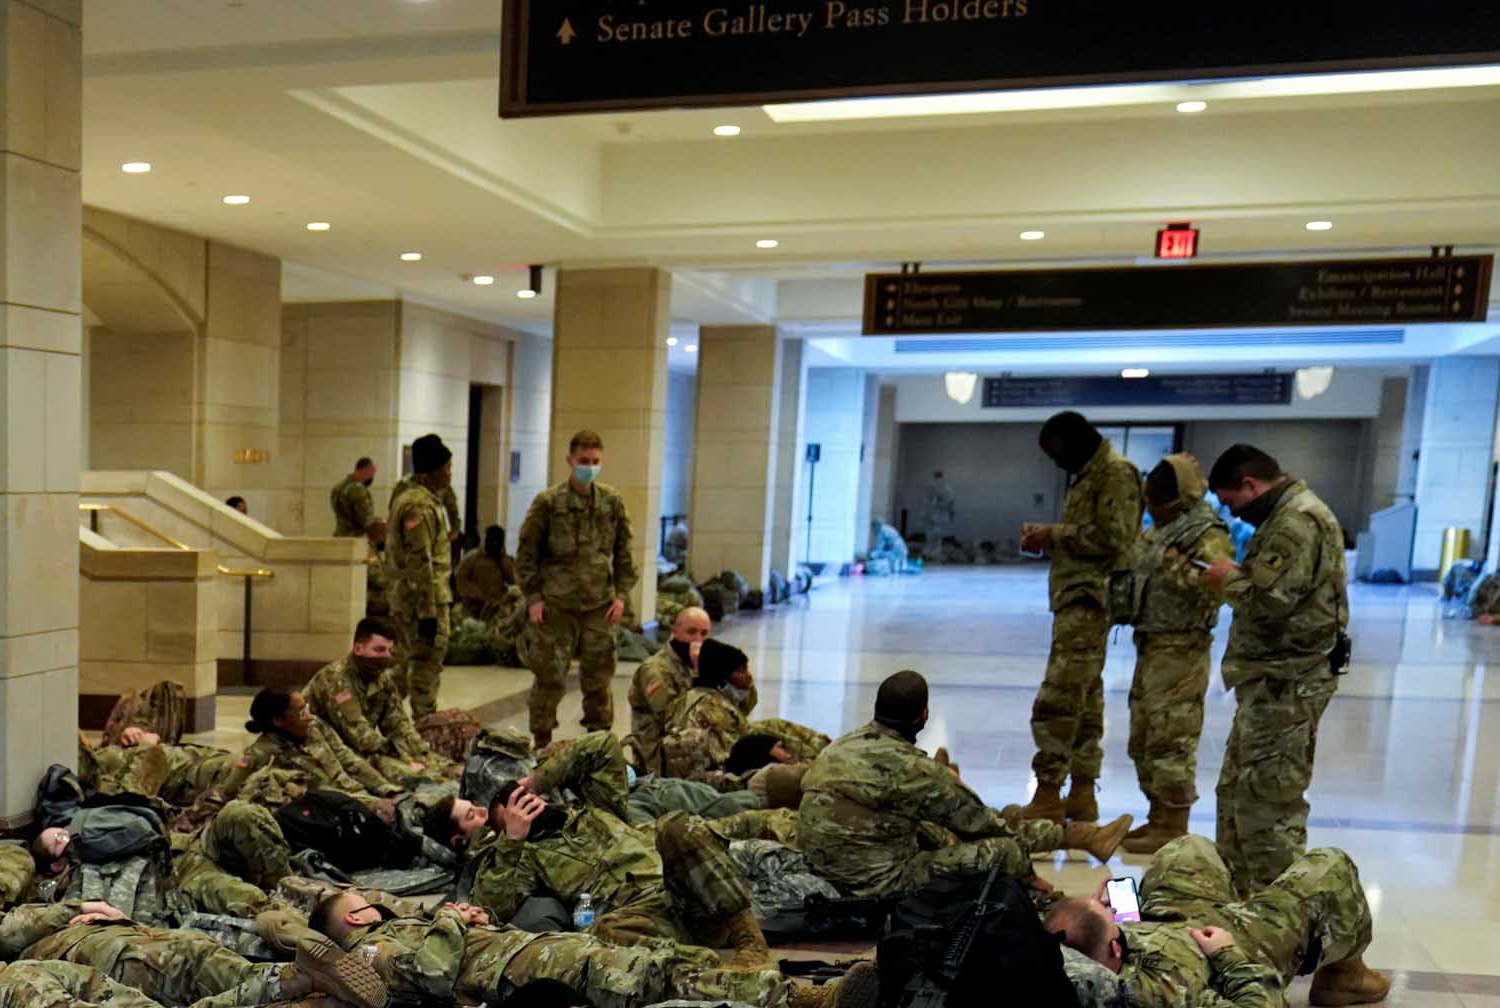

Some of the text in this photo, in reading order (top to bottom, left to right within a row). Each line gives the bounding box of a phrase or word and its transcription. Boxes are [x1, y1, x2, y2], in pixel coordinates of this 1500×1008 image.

[598, 0, 1029, 43] Senate Gallery Pass Holders
[1161, 231, 1195, 257] EXIT
